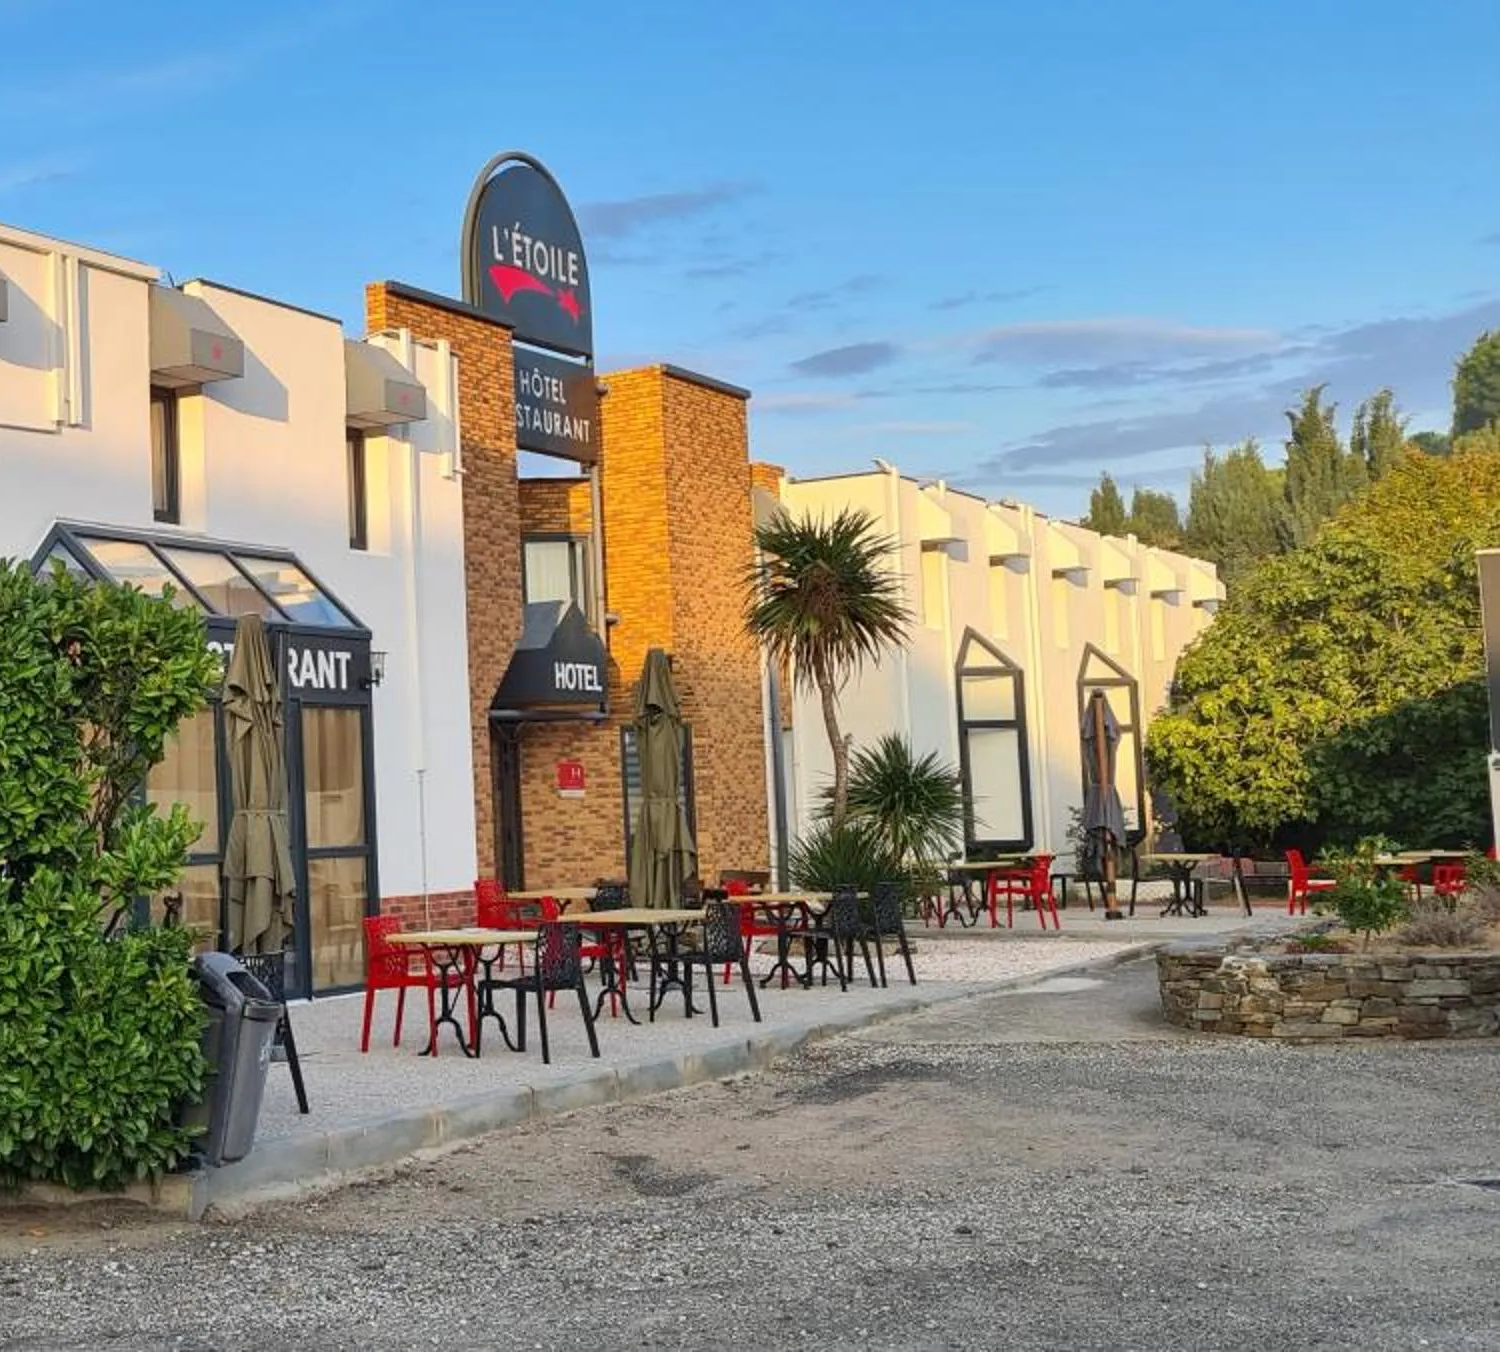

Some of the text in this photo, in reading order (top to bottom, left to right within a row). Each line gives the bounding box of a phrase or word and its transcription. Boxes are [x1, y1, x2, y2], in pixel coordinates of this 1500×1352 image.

[493, 222, 579, 286] L'ÉTOILE
[520, 368, 567, 404] HÔTEL
[555, 662, 603, 691] HOTEL
